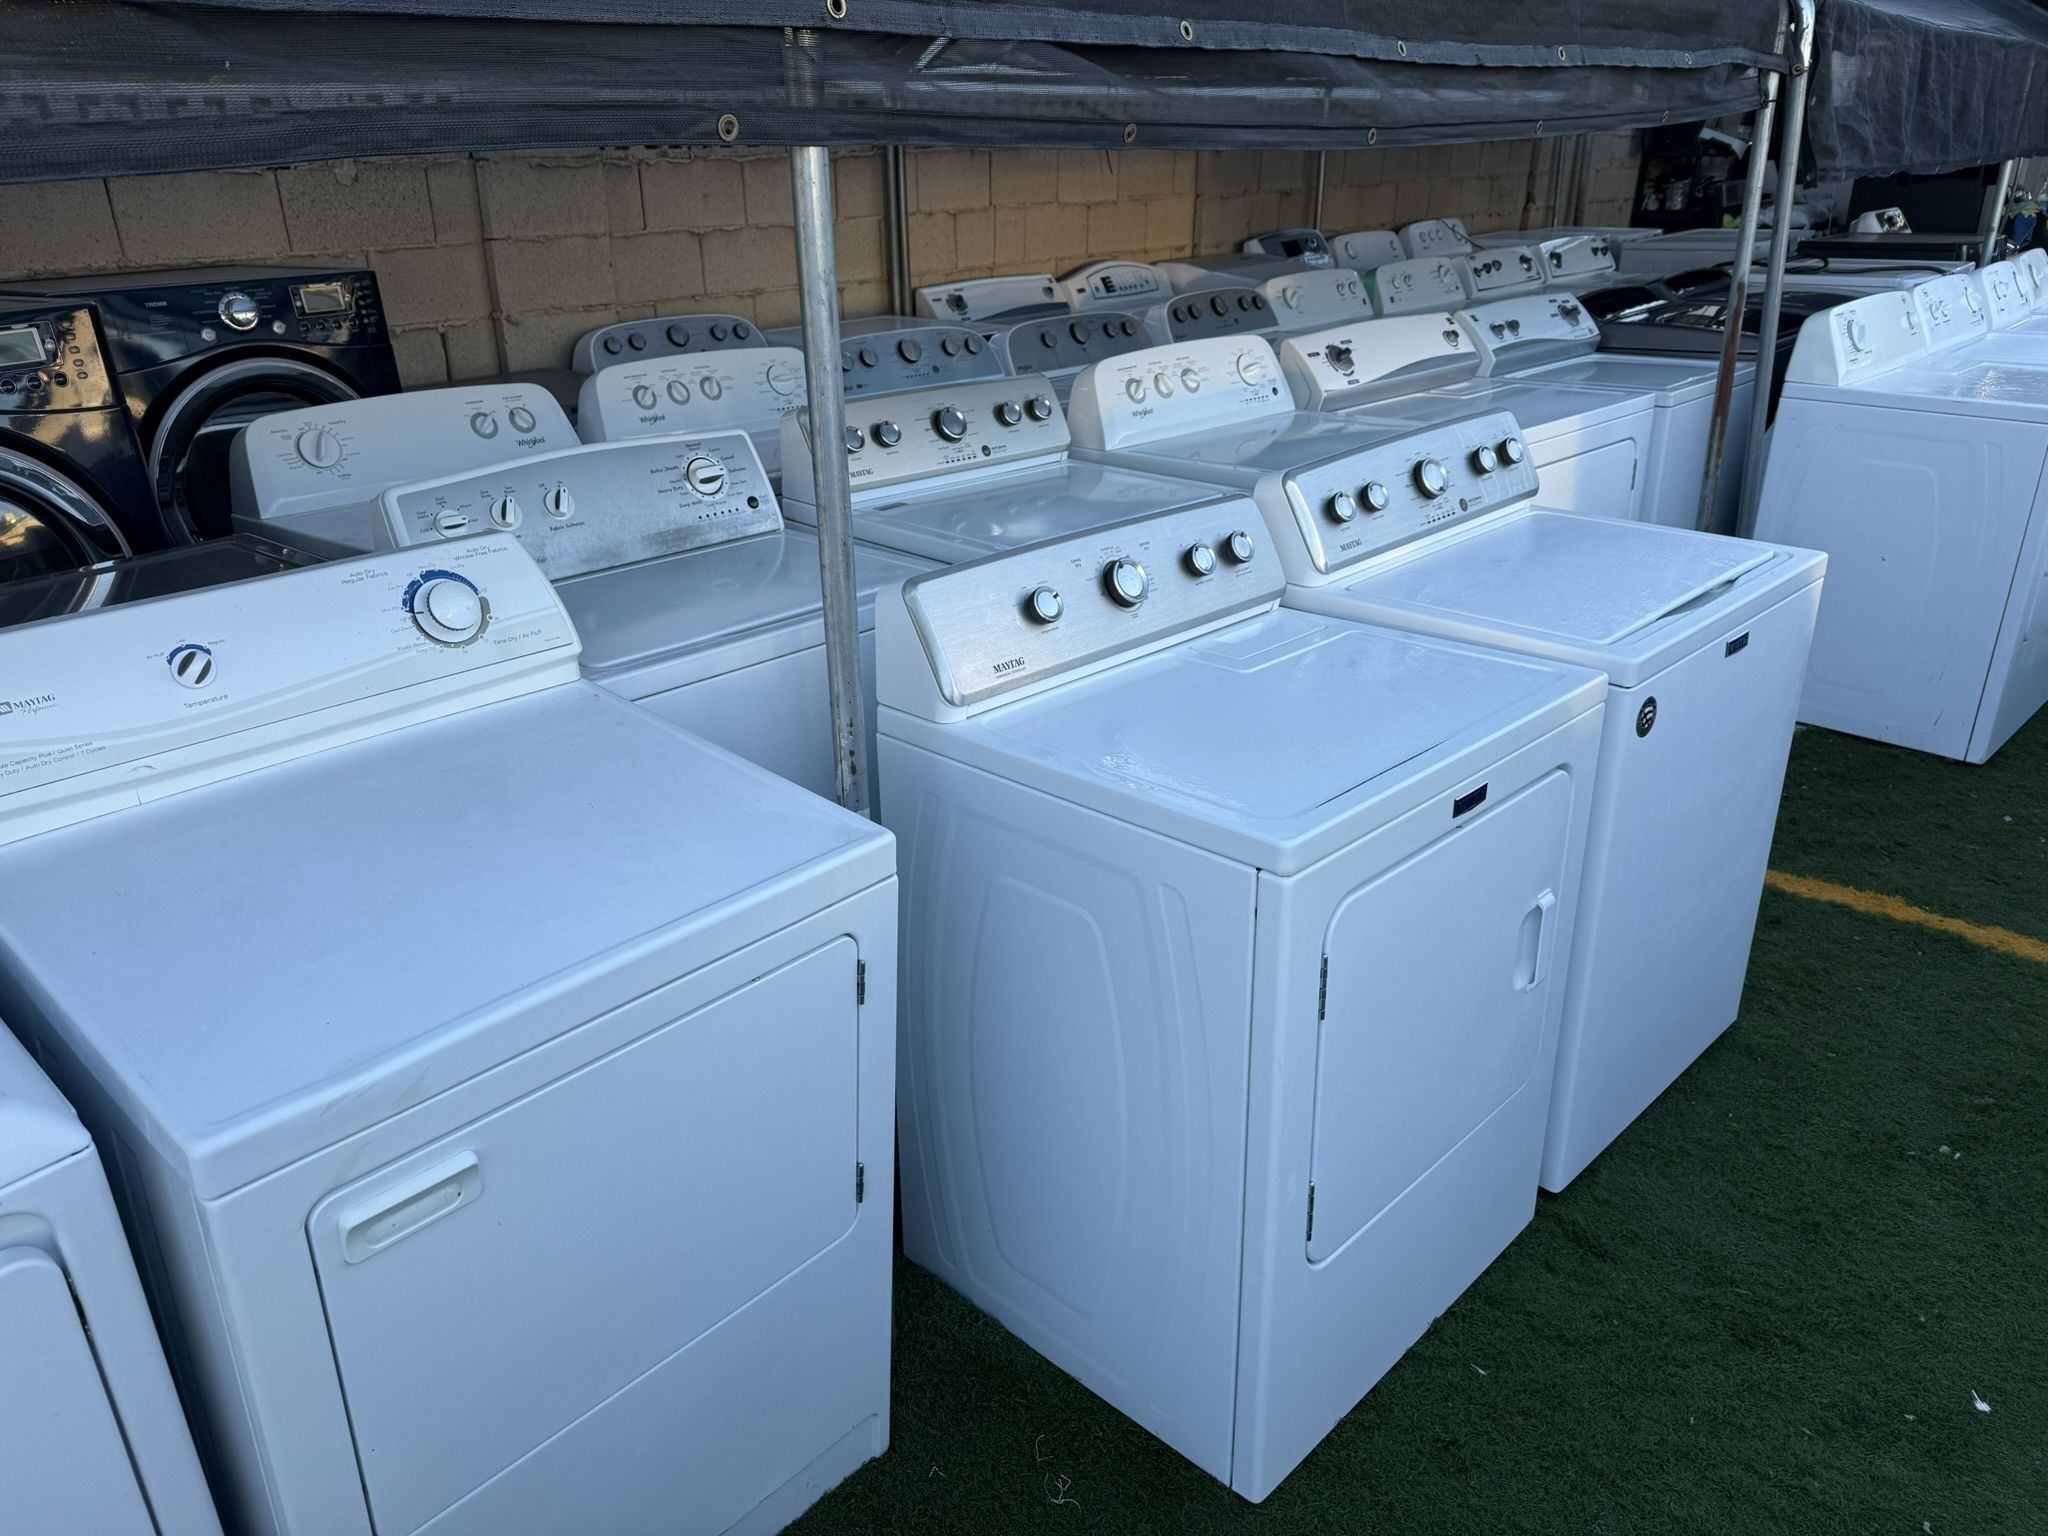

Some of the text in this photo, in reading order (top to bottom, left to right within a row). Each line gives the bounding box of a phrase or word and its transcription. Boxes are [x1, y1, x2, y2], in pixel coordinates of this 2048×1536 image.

[639, 413, 665, 426] Whirlpool
[516, 436, 545, 449] Whirlpool
[992, 656, 1025, 674] MAYTAG
[13, 693, 56, 710] MAYTAG
[183, 694, 228, 708] Temperature
[10, 756, 37, 767] Capacity
[74, 741, 94, 750] Series
[5, 767, 20, 776] Duty
[25, 762, 41, 771] Auto
[41, 759, 52, 768] Dry
[53, 753, 75, 763] Control
